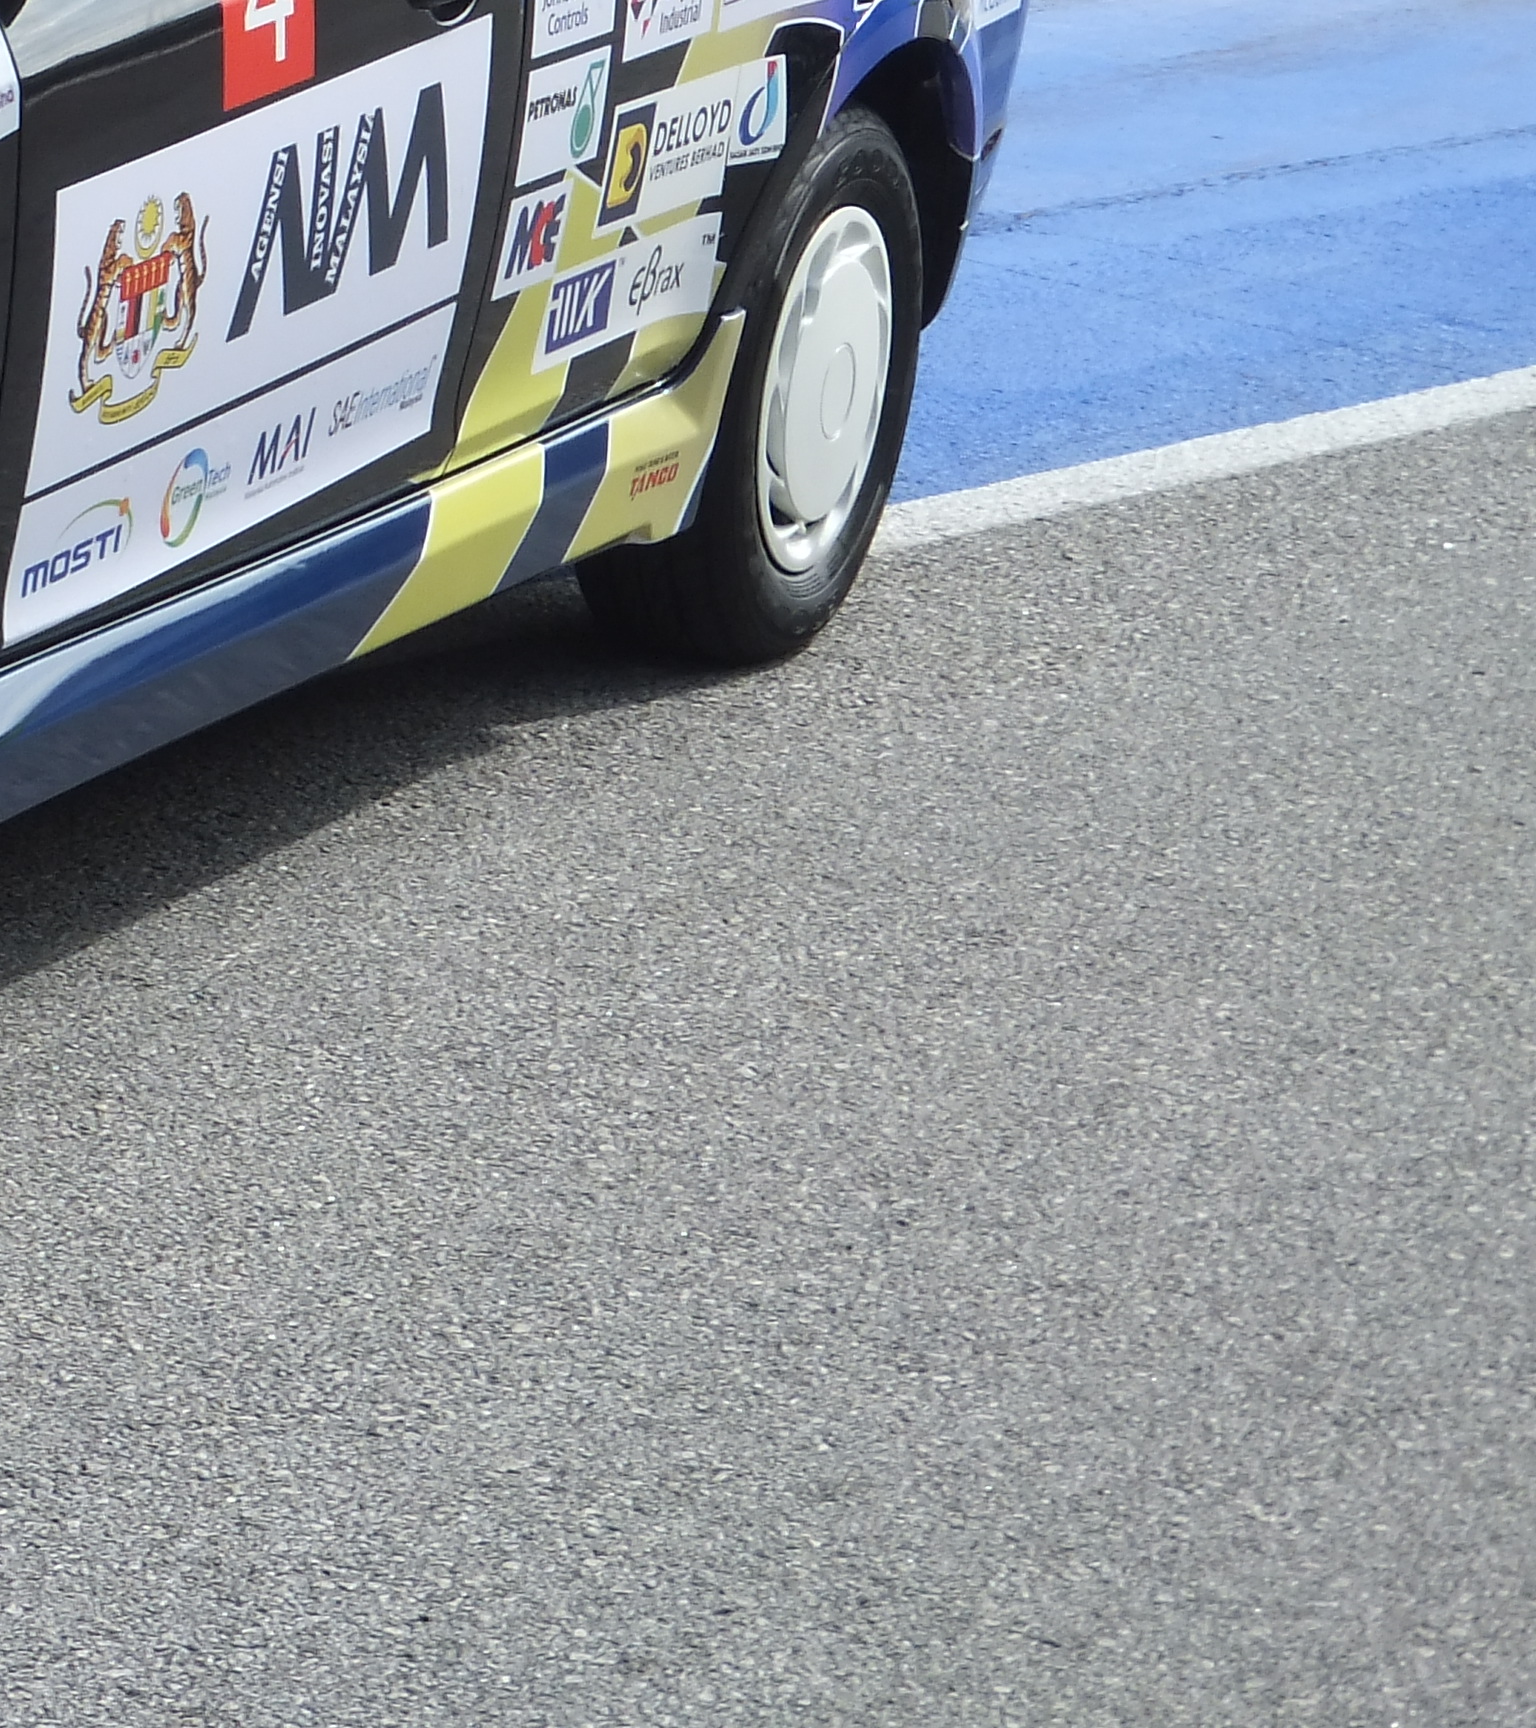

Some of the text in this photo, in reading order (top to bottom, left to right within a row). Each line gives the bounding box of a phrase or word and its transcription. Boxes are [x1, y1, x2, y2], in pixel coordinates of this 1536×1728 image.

[547, 5, 589, 37] Controls
[528, 85, 578, 123] PETRONAS
[653, 99, 732, 157] DELLOYD
[251, 149, 290, 284] AGENSI
[310, 127, 335, 272] INOVASI
[325, 113, 376, 286] MALAYSIA
[504, 192, 567, 279] MCE
[248, 406, 317, 485] MAI
[21, 523, 123, 599] MOSTI
